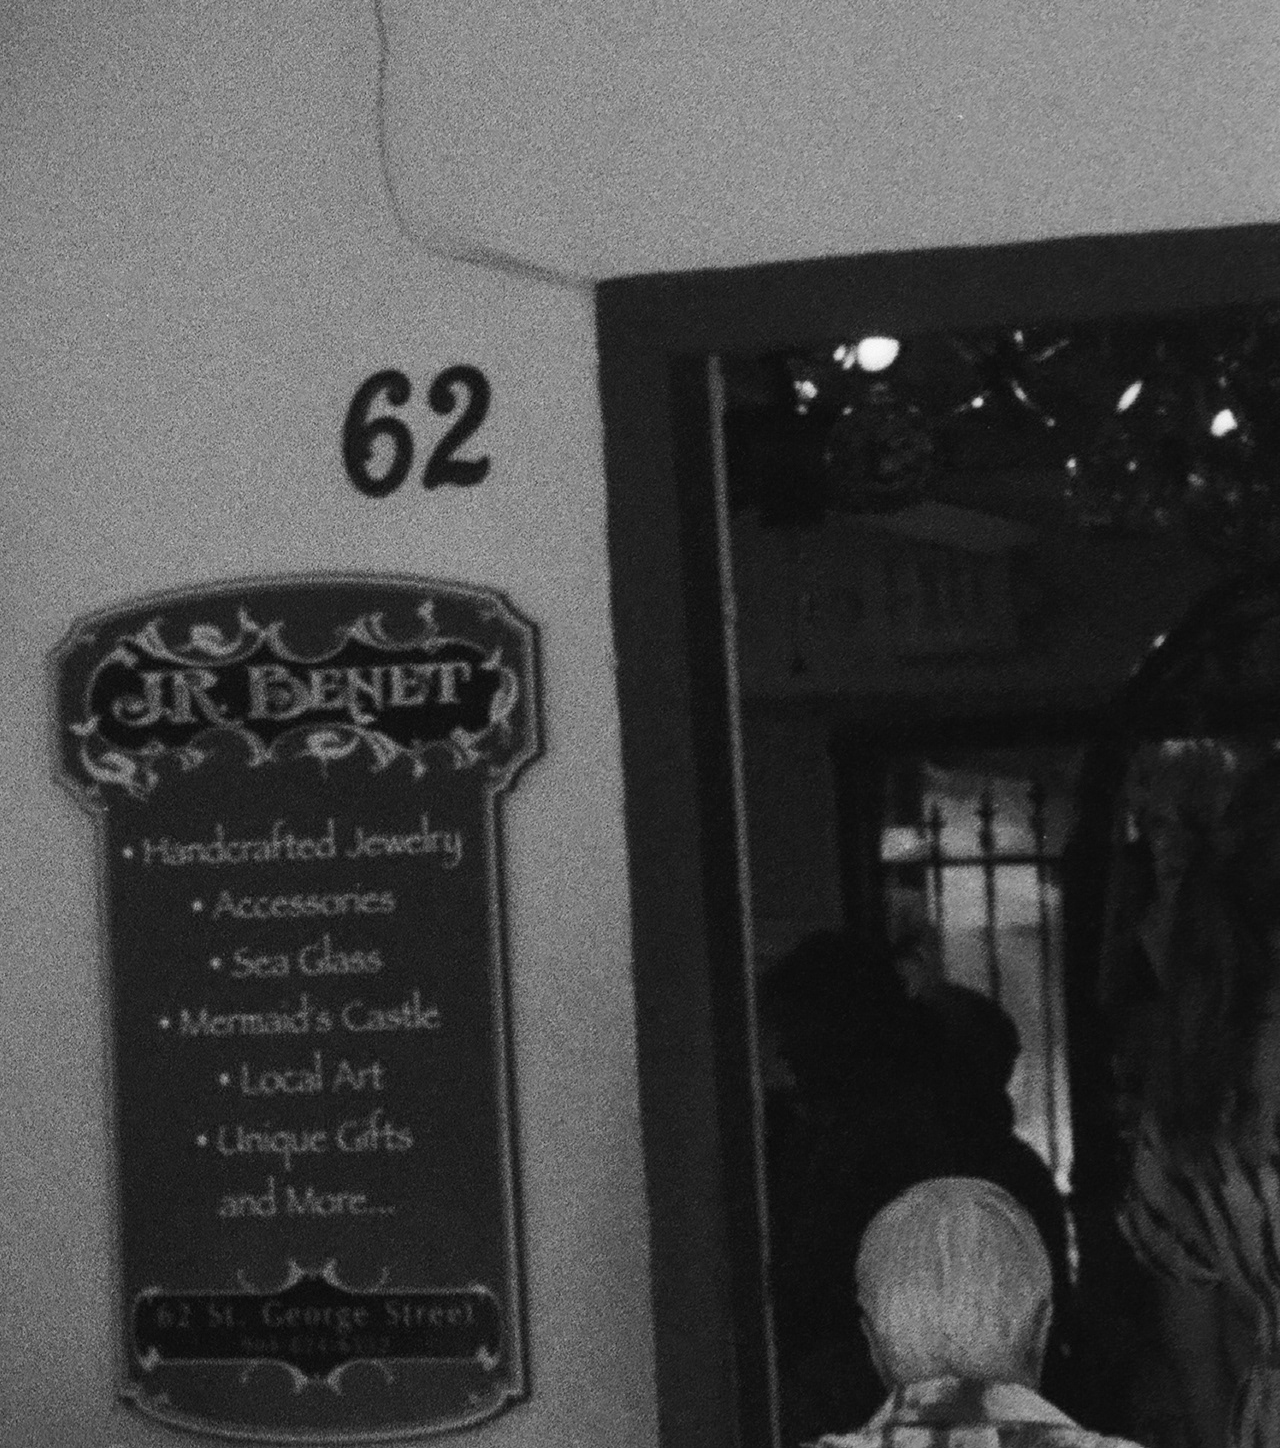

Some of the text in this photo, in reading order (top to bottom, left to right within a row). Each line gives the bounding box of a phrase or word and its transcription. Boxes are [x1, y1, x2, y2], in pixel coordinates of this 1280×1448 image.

[342, 364, 491, 498] 62
[141, 812, 464, 870] Handcrafted Jewelry
[212, 883, 397, 921] Accessories
[230, 932, 386, 979] Sea Glass
[180, 987, 441, 1036] Mermaid's Castle
[239, 1049, 385, 1095] Local Art
[216, 1107, 415, 1171] Unique Gifts
[217, 1175, 276, 1217] and
